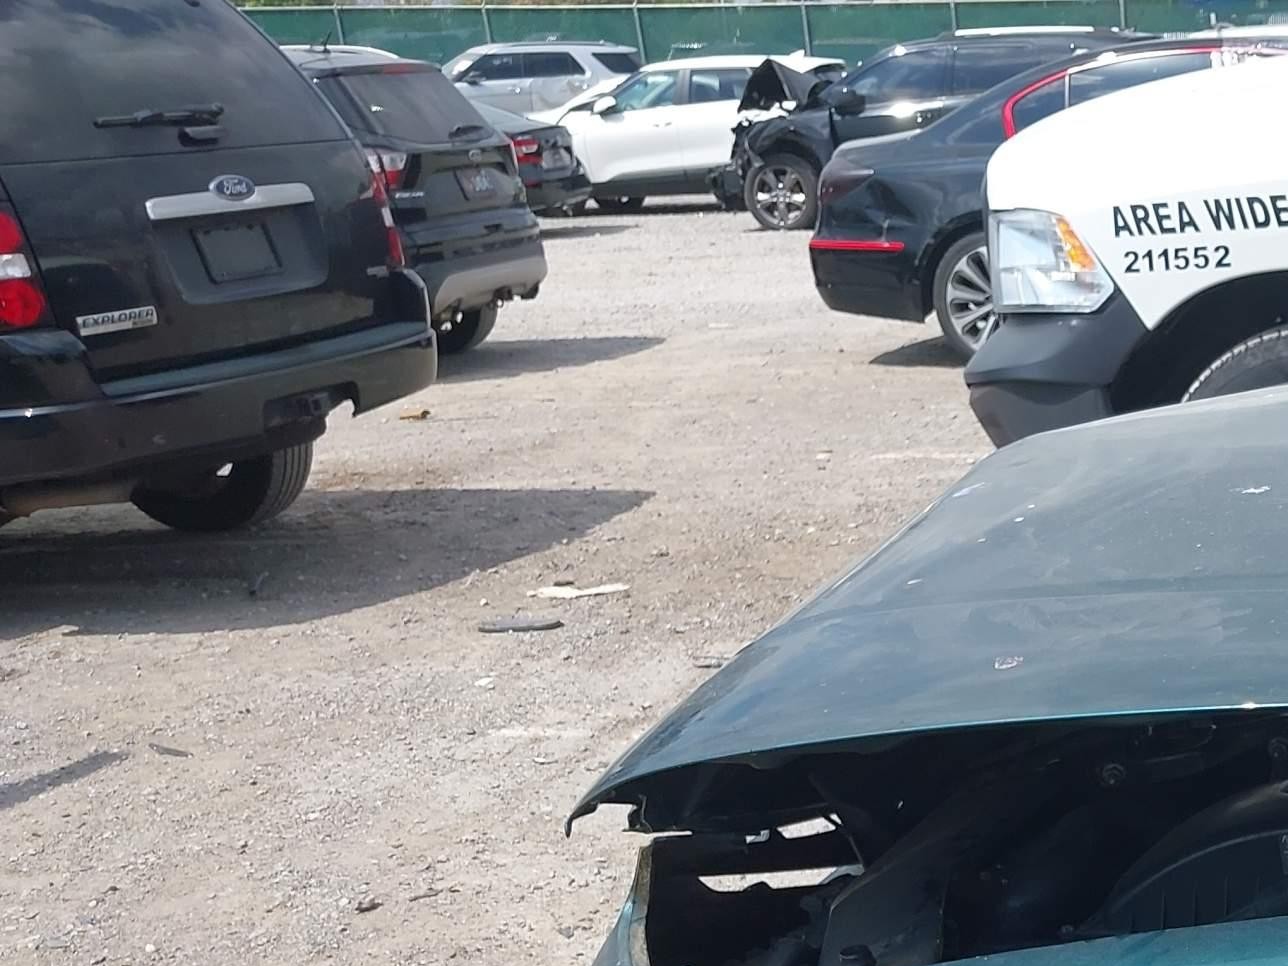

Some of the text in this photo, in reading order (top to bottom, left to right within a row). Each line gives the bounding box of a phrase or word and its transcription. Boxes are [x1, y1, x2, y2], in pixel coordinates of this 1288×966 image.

[1112, 201, 1200, 238] AREA
[1124, 245, 1231, 273] 211552
[82, 308, 154, 328] EXPLORER
